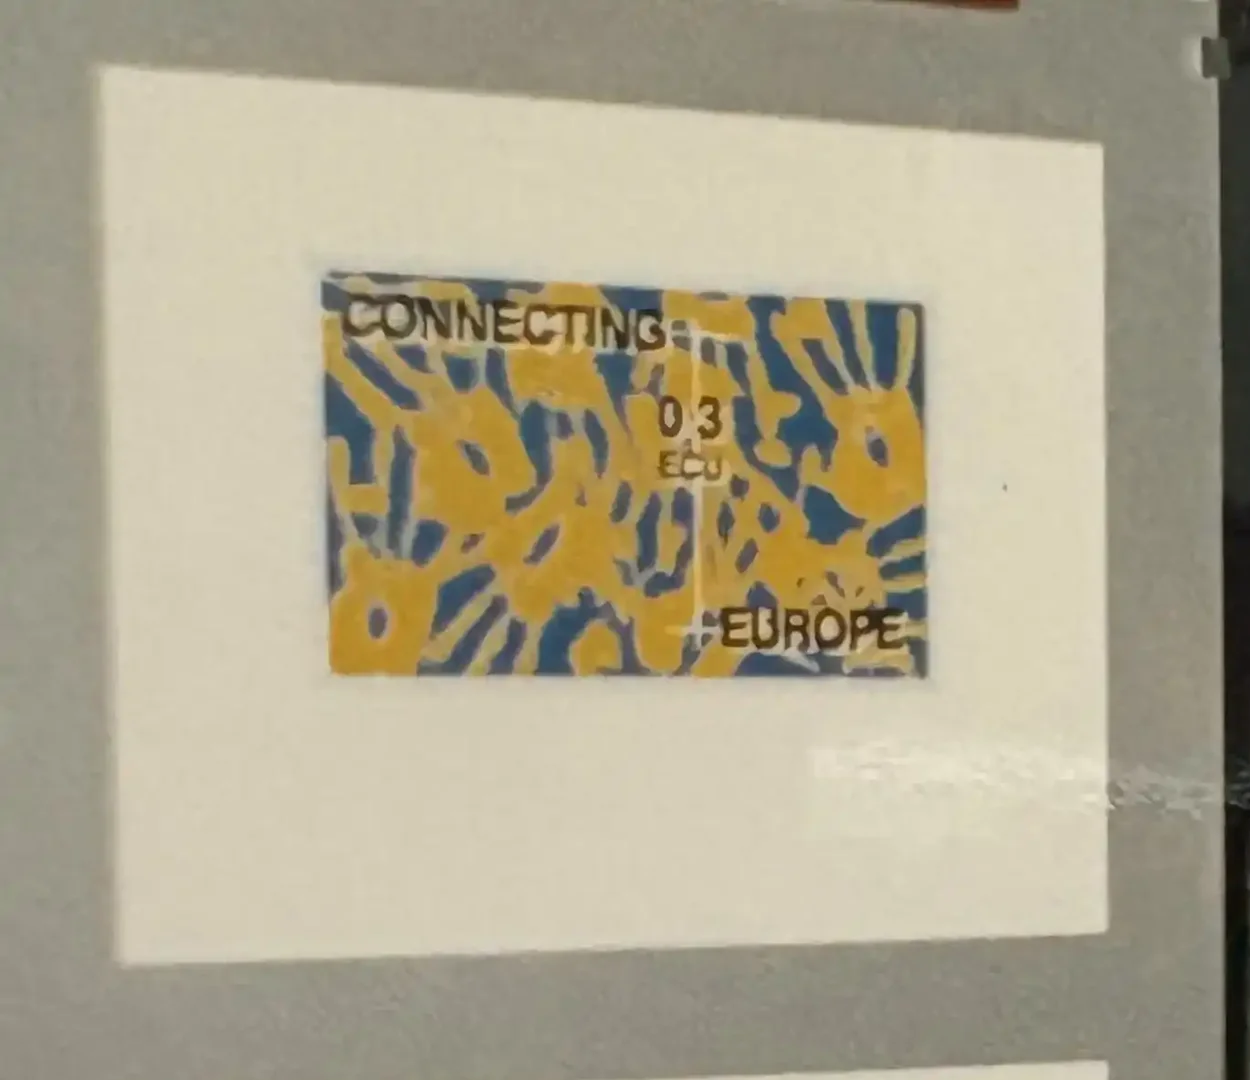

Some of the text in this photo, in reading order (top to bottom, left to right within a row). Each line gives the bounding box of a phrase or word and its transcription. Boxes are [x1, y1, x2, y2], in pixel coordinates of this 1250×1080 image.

[343, 294, 667, 351] CONNECTING
[658, 450, 723, 481] ECU
[720, 606, 908, 650] EUROPE
